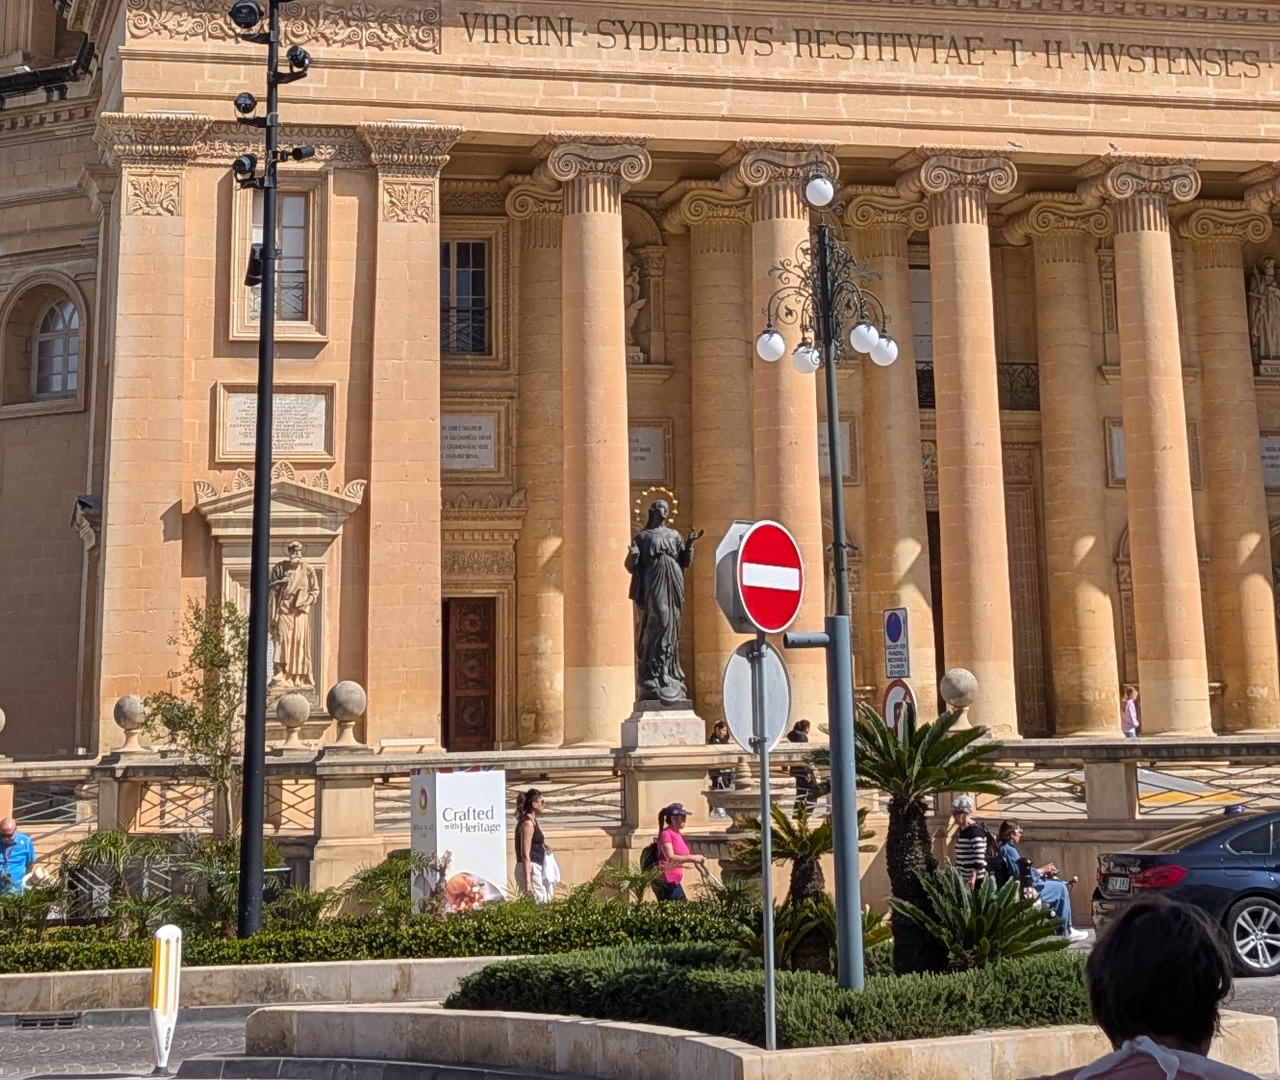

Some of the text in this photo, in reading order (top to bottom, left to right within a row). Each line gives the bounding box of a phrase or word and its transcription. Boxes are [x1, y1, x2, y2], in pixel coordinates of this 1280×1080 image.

[459, 12, 574, 47] VIRGINI
[596, 18, 774, 57] SYDERIBVS
[793, 27, 985, 67] RESTITVTAE
[1081, 41, 1262, 79] MVSTENSES
[442, 805, 494, 822] Crafted
[460, 822, 501, 834] Heritage
